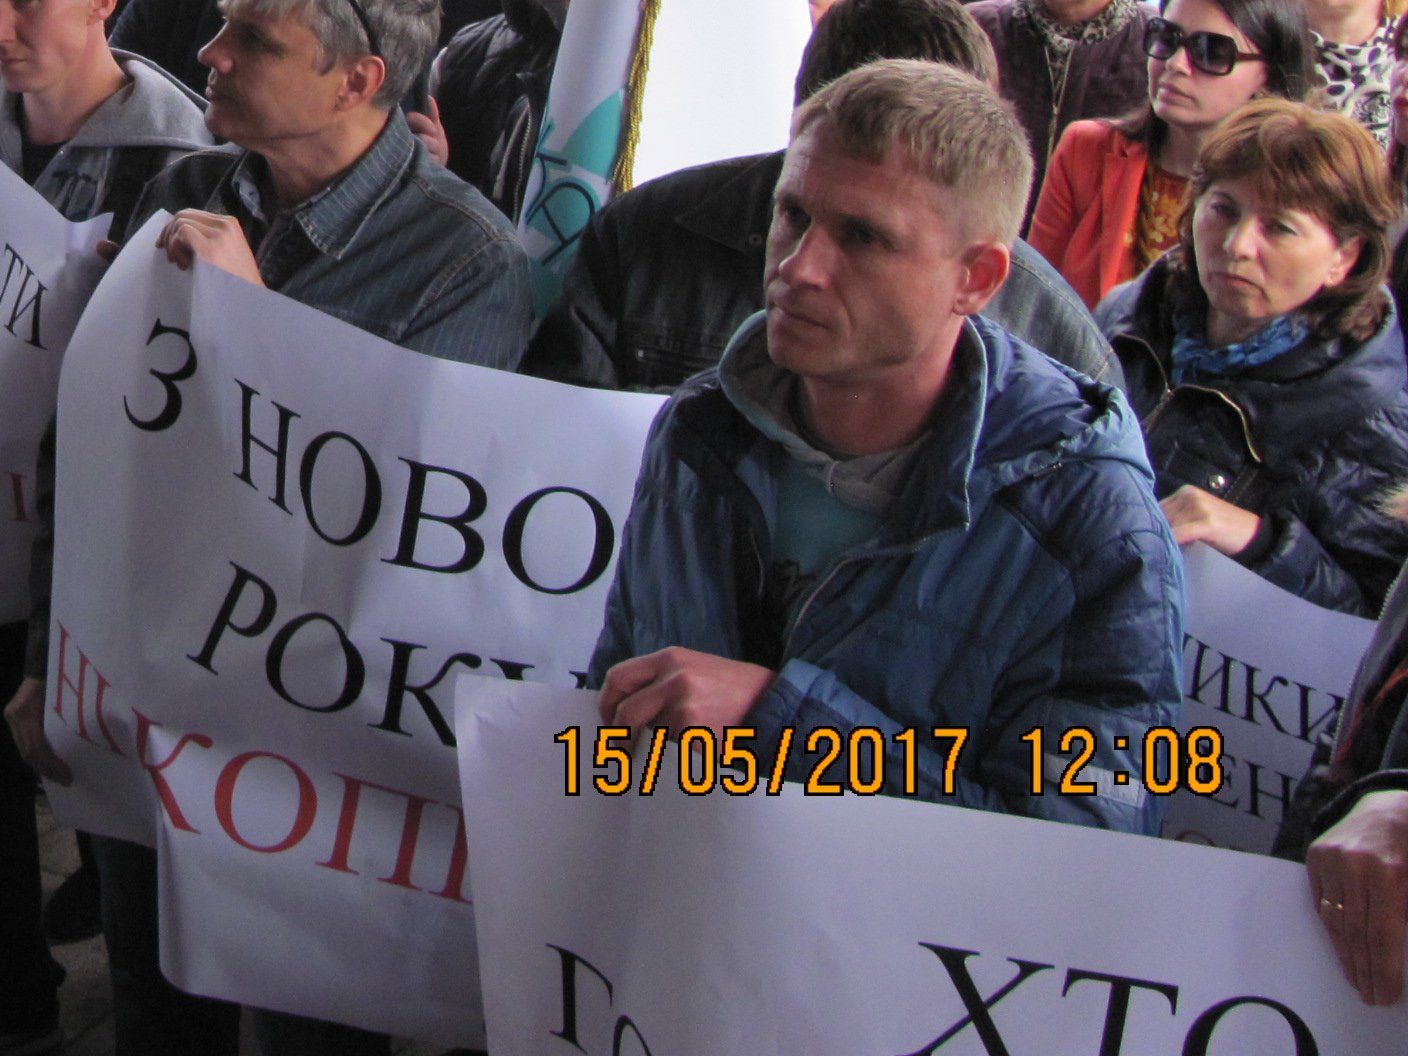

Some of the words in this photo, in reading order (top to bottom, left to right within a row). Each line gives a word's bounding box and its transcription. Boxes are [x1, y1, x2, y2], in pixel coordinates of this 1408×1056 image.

[123, 317, 199, 432] З
[232, 378, 616, 595] НОВО
[186, 561, 589, 748] РОК
